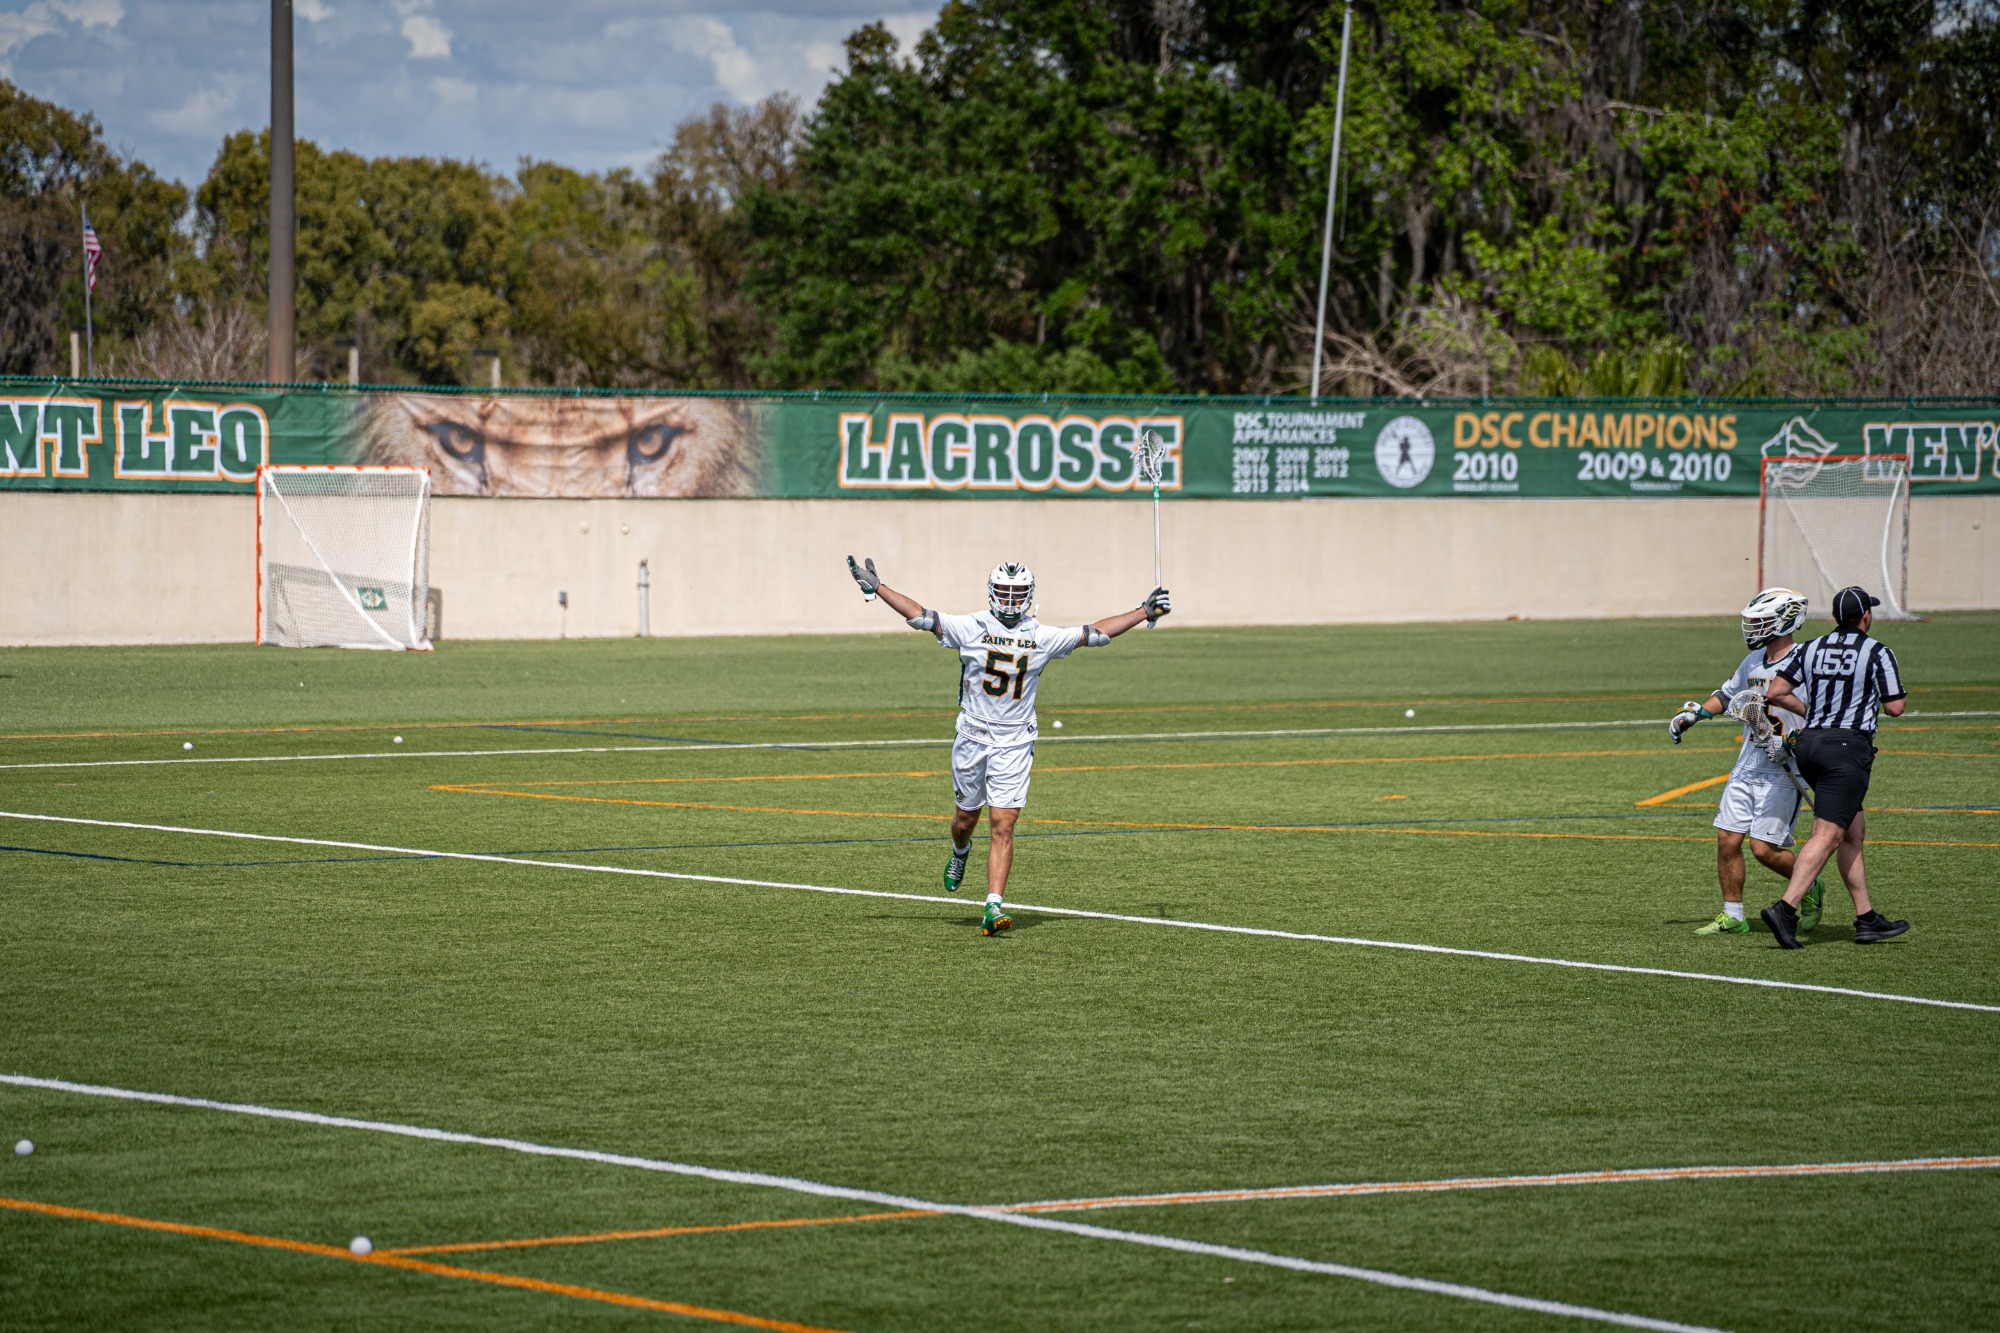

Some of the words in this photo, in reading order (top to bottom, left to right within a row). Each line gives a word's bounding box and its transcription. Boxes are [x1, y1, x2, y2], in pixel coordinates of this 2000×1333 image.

[1233, 411, 1264, 429] DSC
[1266, 412, 1367, 429] TOURNAMENT
[1453, 411, 1524, 449] DSC
[1528, 412, 1738, 450] CHAMPIONS
[114, 399, 269, 482] LEO
[1232, 429, 1337, 444] APPEARANCES
[839, 412, 1183, 491] LACROSSE
[1232, 447, 1270, 463] 2007
[1314, 447, 1350, 464] 2009
[1452, 451, 1519, 481] 2010
[1863, 421, 2000, 482] MEN'
[1232, 463, 1270, 478] 2010
[1275, 463, 1308, 478] 2011
[1313, 463, 1349, 478] 2012
[1577, 451, 1647, 481] 2009
[1650, 457, 1664, 478] &
[1668, 452, 1732, 482] 2010
[1232, 478, 1269, 493] 2013
[1274, 478, 1310, 493] 2014
[981, 635, 1014, 646] SAINT
[1017, 639, 1037, 650] LEO
[982, 649, 1029, 700] 51
[1812, 648, 1858, 676] 153
